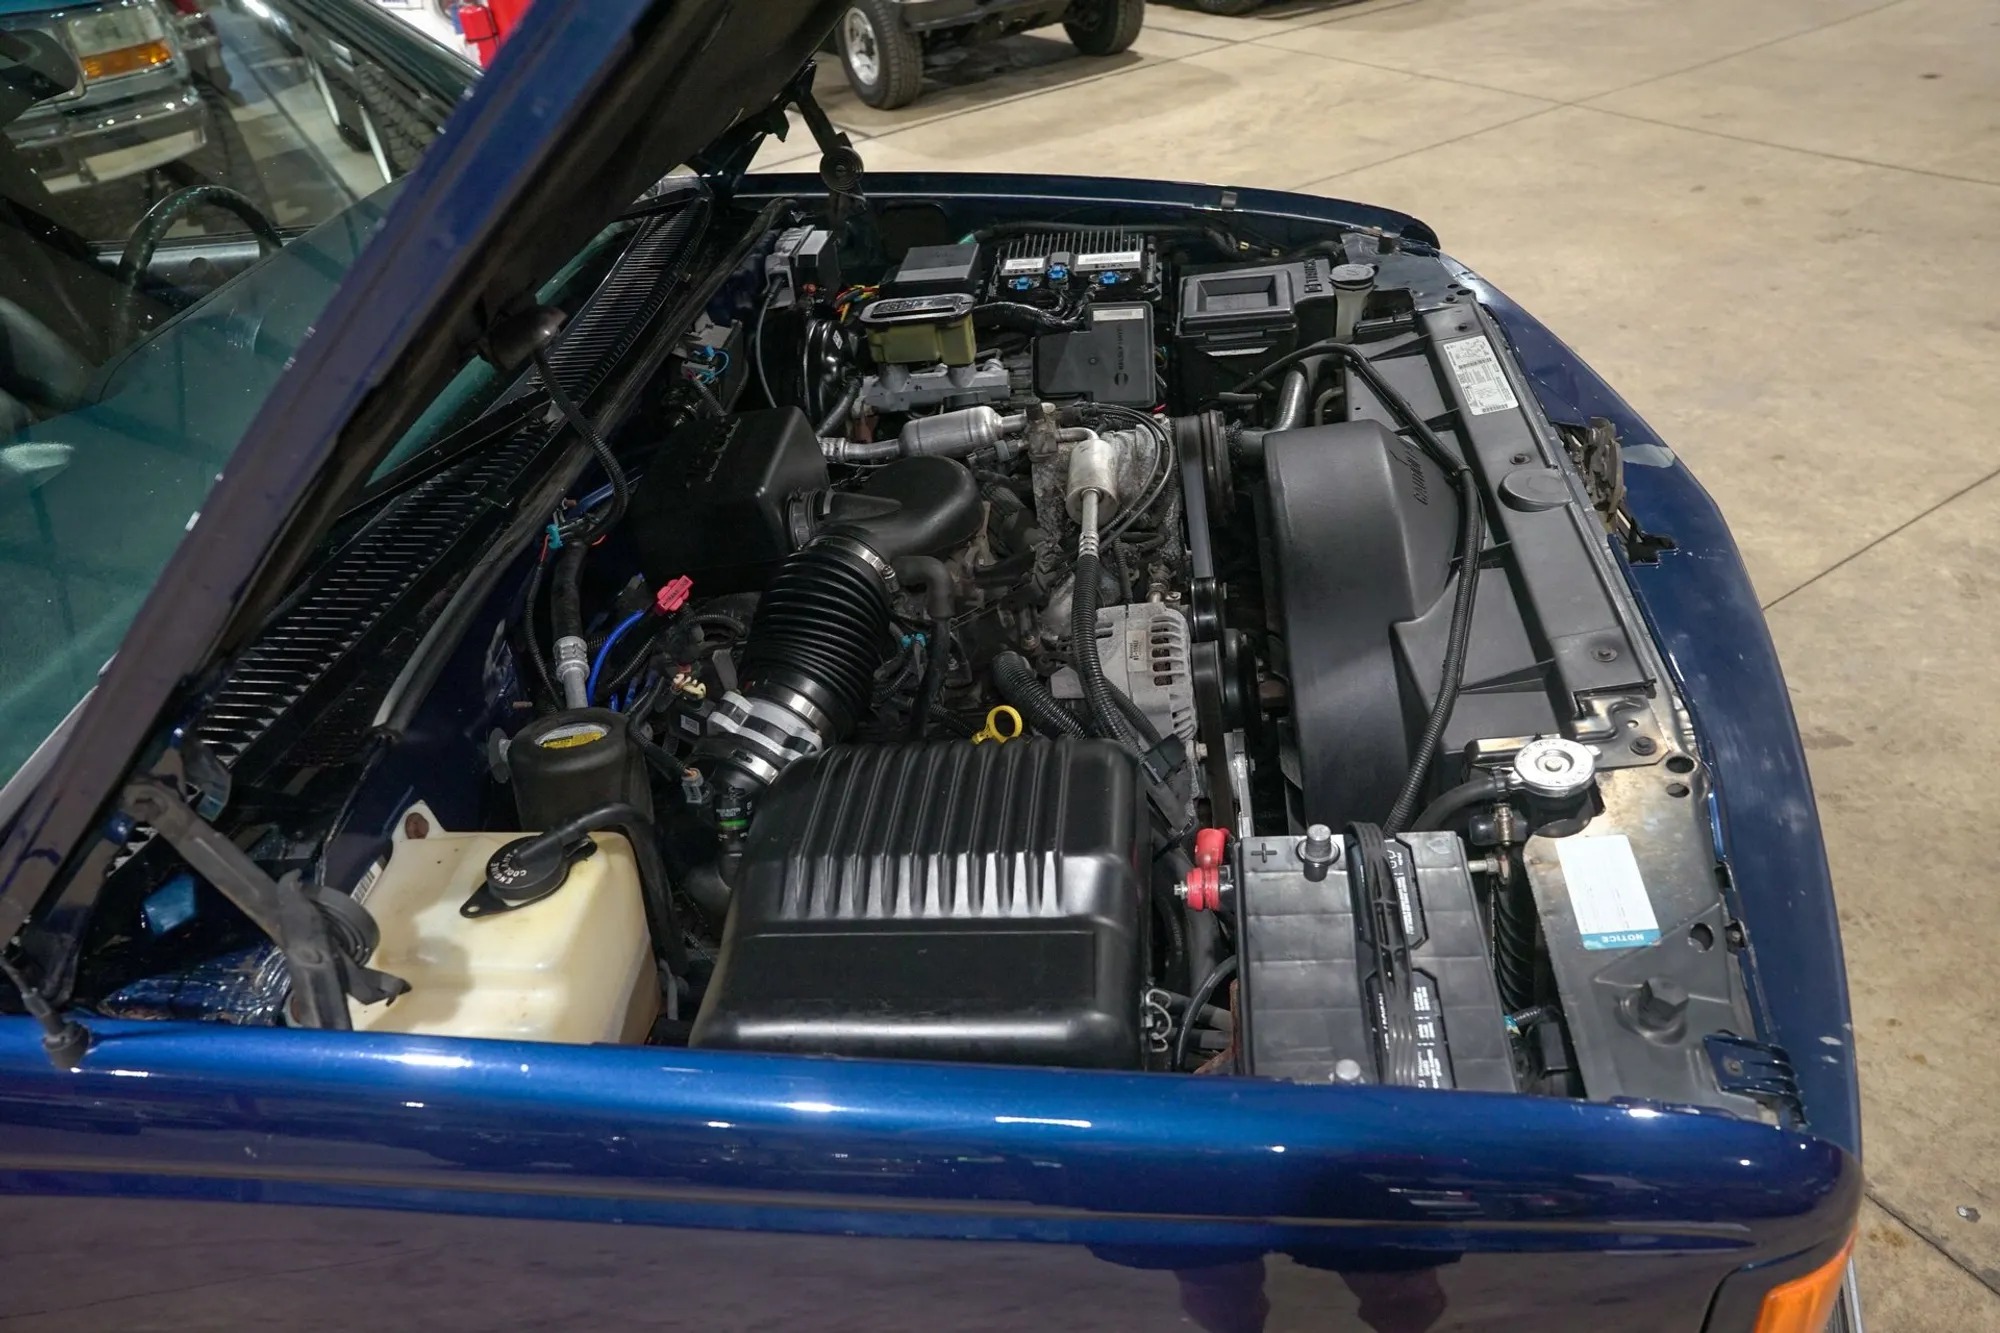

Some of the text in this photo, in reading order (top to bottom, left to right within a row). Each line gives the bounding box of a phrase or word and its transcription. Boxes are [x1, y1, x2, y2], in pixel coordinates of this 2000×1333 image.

[490, 862, 514, 884] ENGINE
[501, 852, 528, 877] COOLANT
[1601, 933, 1645, 944] NOTICE
